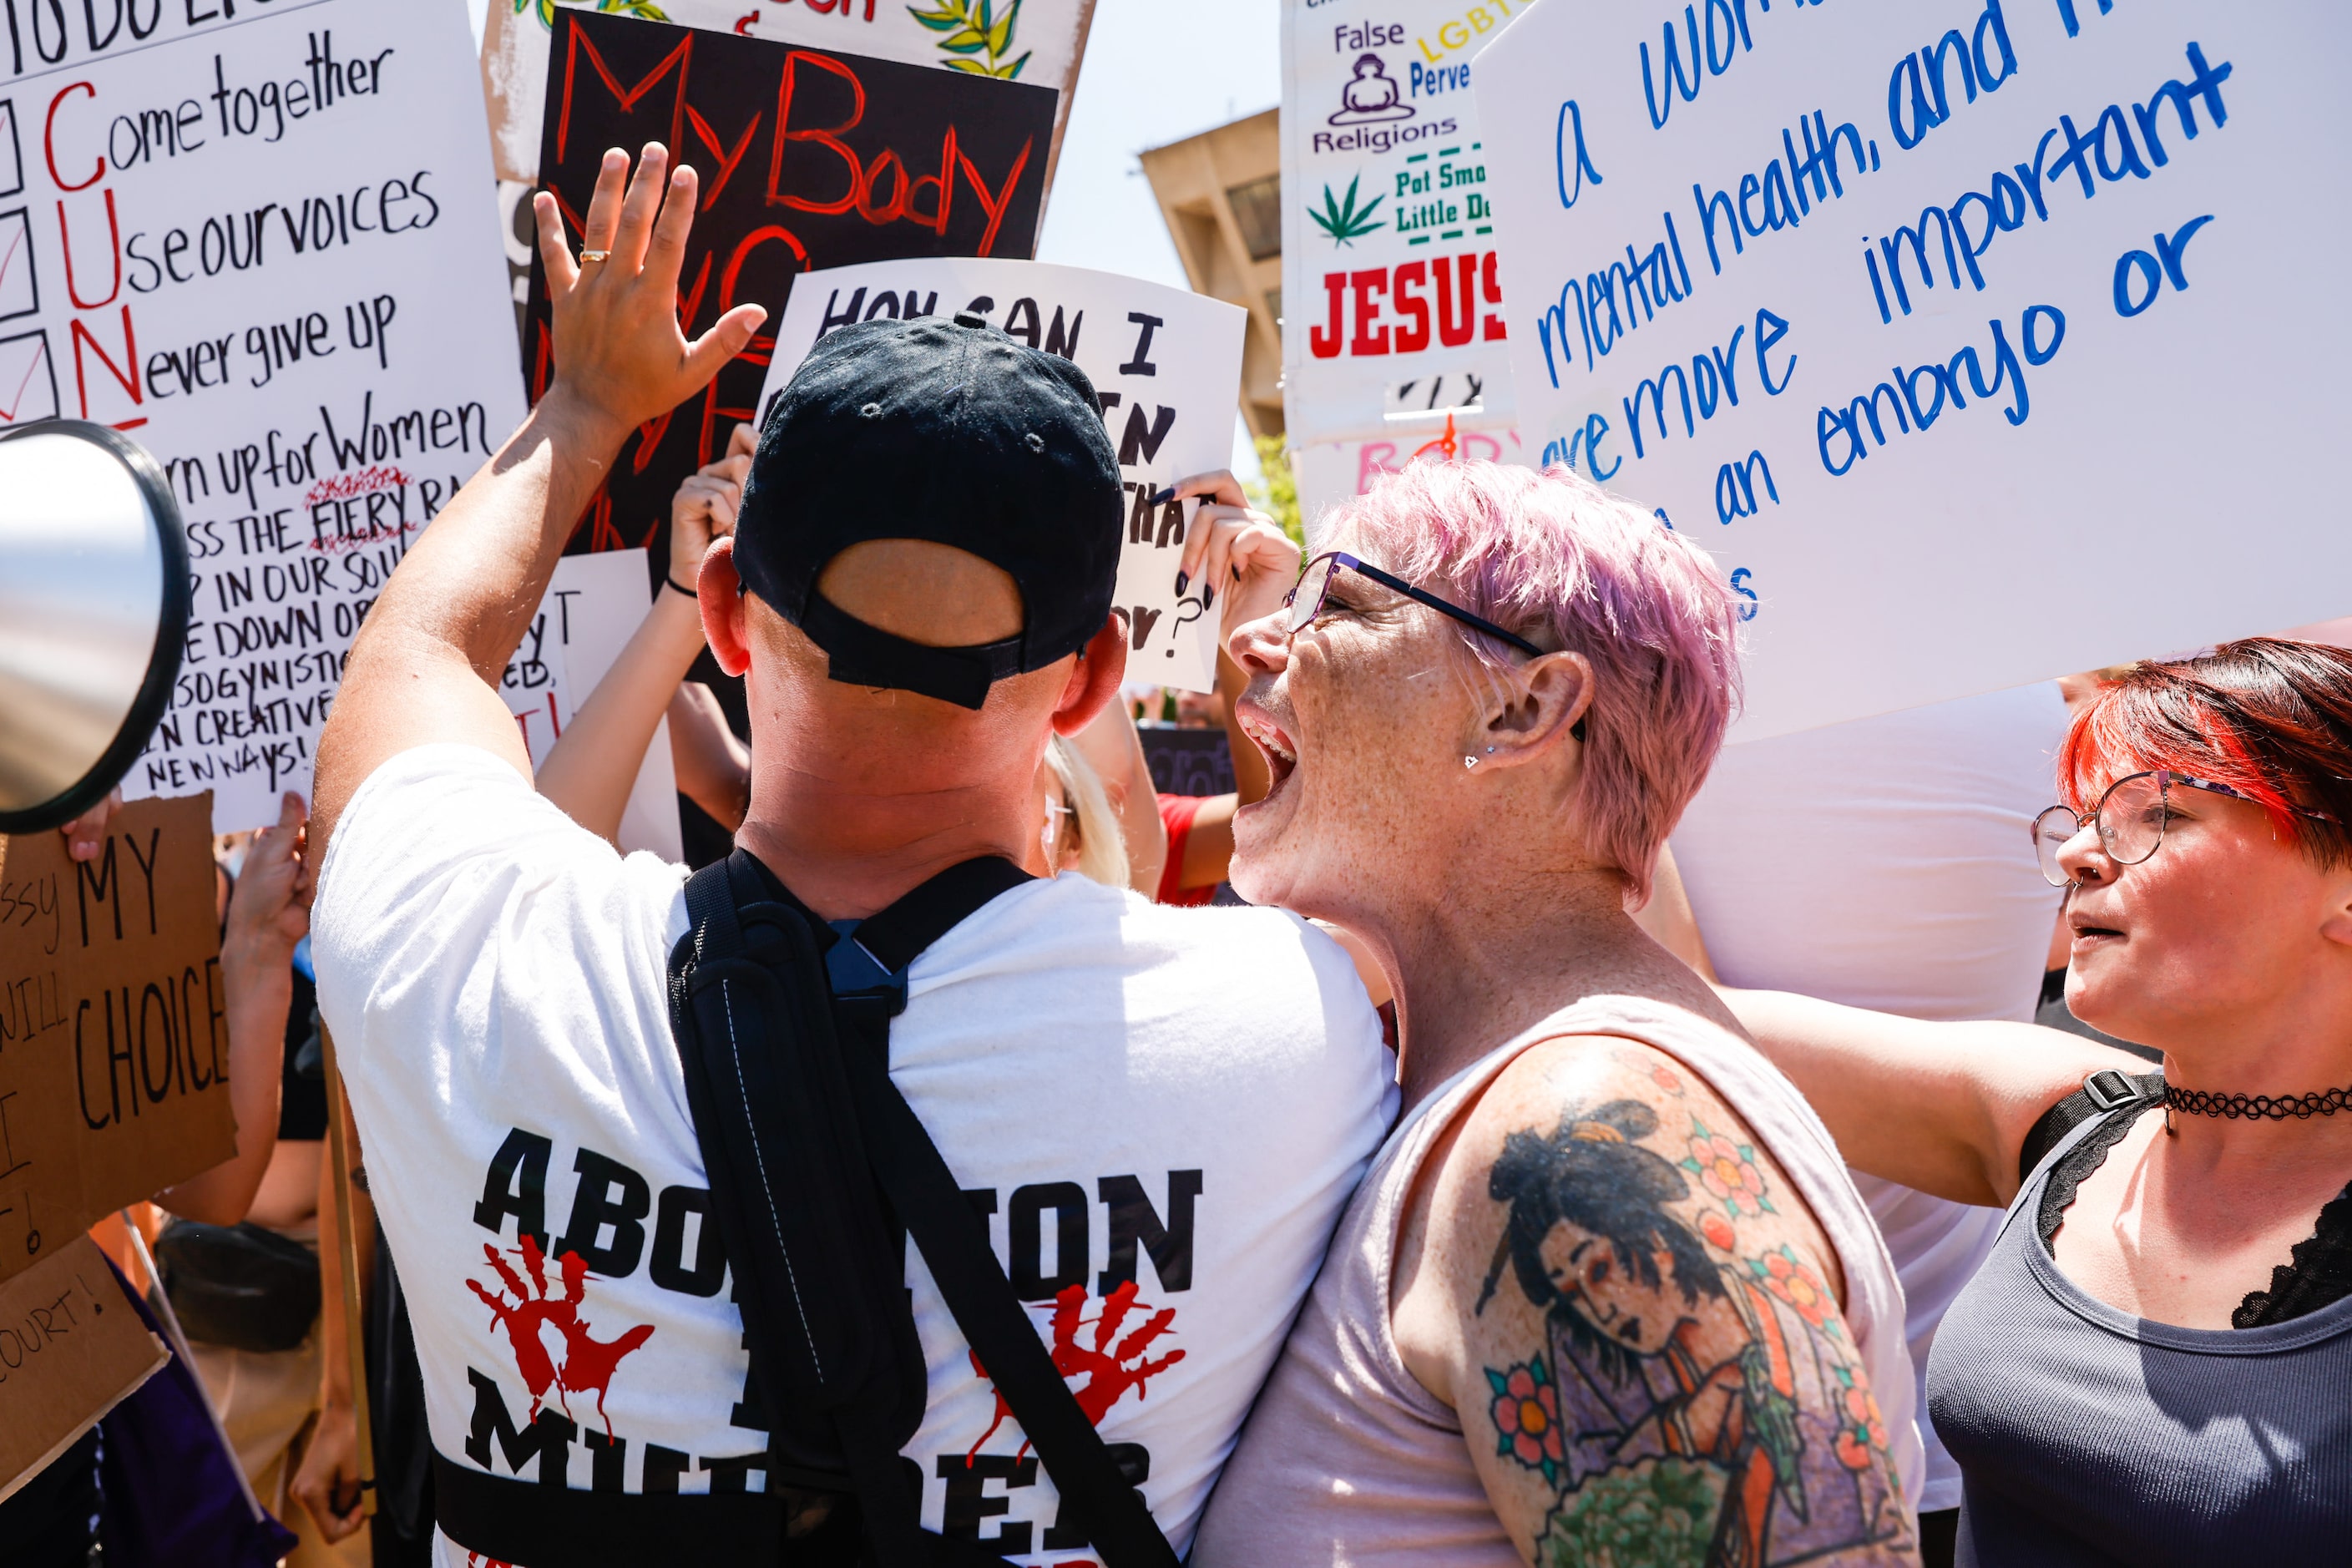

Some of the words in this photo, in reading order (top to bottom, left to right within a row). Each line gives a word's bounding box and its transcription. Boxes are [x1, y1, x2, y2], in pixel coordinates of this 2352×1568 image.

[1334, 20, 1404, 53] False
[1410, 62, 1470, 99] Perve
[44, 80, 205, 192] Come
[210, 30, 394, 142] together
[1313, 117, 1458, 154] Religions
[1555, 99, 1602, 209] a
[1396, 172, 1430, 197] Pot
[1396, 199, 1458, 232] Little
[1536, 210, 1694, 389] mental
[1692, 109, 1881, 276] health,
[1888, 0, 2018, 150] and
[57, 188, 195, 310] Use
[200, 202, 278, 276] our
[281, 170, 439, 254] voices
[1623, 307, 1797, 458] more
[1863, 41, 2233, 324] important
[70, 304, 235, 420] Never
[245, 312, 336, 388] give
[345, 293, 397, 369] up
[1119, 311, 1164, 377] I
[1716, 448, 1780, 525] an
[1815, 304, 2066, 477] embryo
[2113, 214, 2215, 318] or
[218, 444, 265, 511] up
[261, 429, 319, 488] for
[319, 391, 493, 471] Women
[230, 508, 303, 554] THE
[311, 479, 407, 557] FIERY
[214, 600, 323, 659] DOWN
[215, 566, 254, 613] IN
[263, 557, 338, 603] OUR
[219, 735, 311, 793] WAYS!
[77, 827, 160, 948] MY
[76, 956, 229, 1130] CHOICE
[0, 1274, 104, 1383] OURT!
